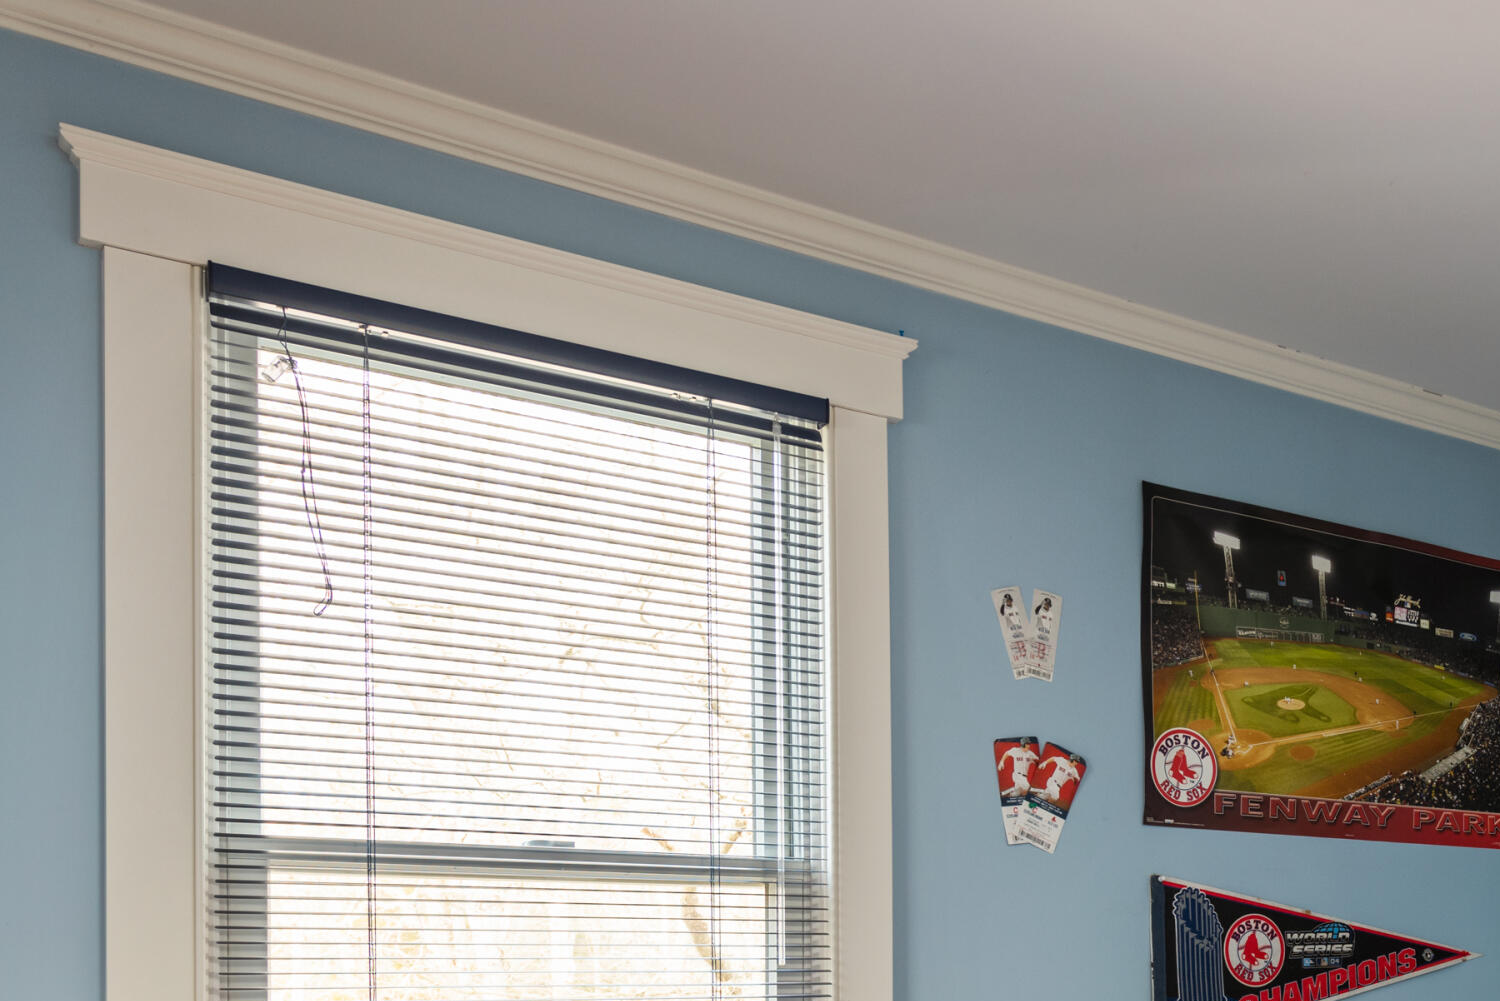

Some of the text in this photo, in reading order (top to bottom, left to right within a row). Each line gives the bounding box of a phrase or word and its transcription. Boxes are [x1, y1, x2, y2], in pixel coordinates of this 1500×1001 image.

[1158, 734, 1210, 760] BOSTON
[1160, 779, 1209, 802] RED SOX
[1213, 792, 1396, 827] FENWAY
[1231, 919, 1278, 943] BOSTON
[1286, 931, 1351, 944] WORLD
[1291, 943, 1353, 956] SERIES
[1234, 960, 1278, 982] RED SOX
